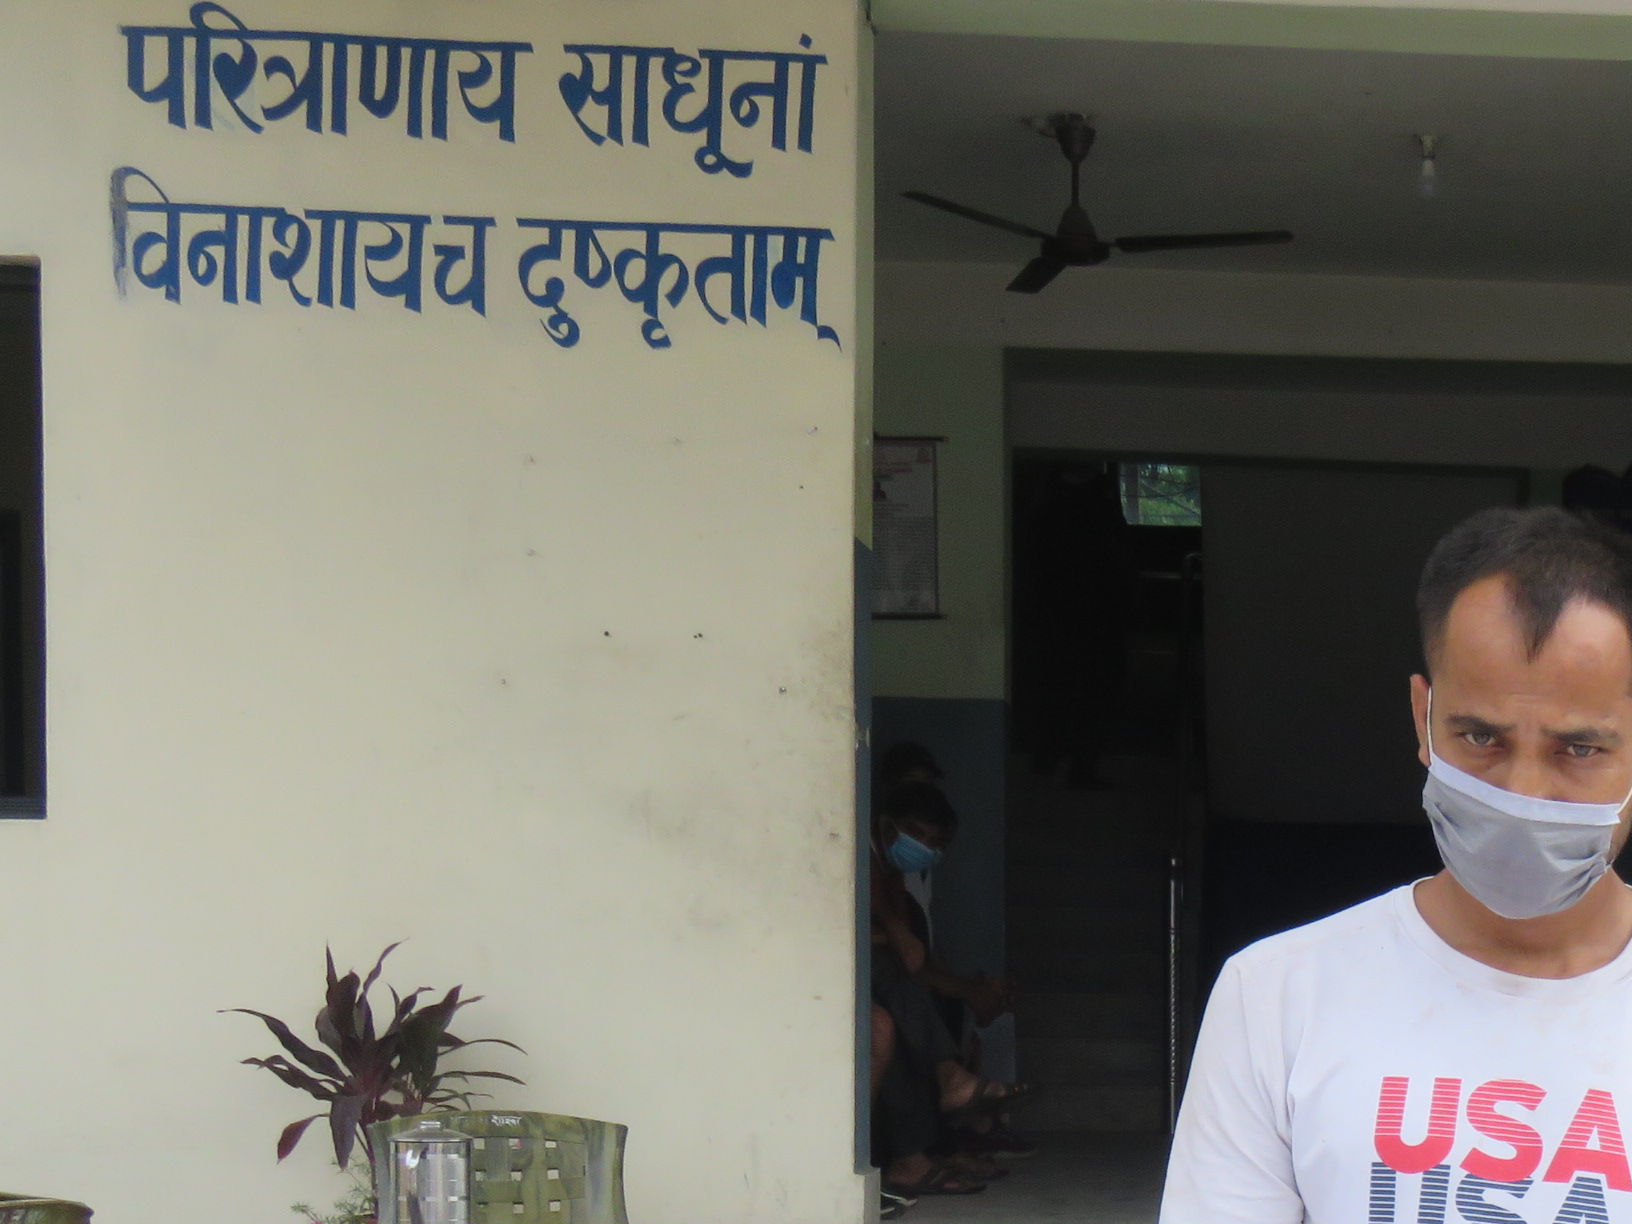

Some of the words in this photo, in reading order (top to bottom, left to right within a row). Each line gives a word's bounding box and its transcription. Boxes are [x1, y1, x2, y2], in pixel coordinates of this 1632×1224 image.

[119, 2, 533, 143] परित्राणाय
[558, 33, 829, 179] साधूनां
[515, 216, 842, 352] दुष्कृताम्
